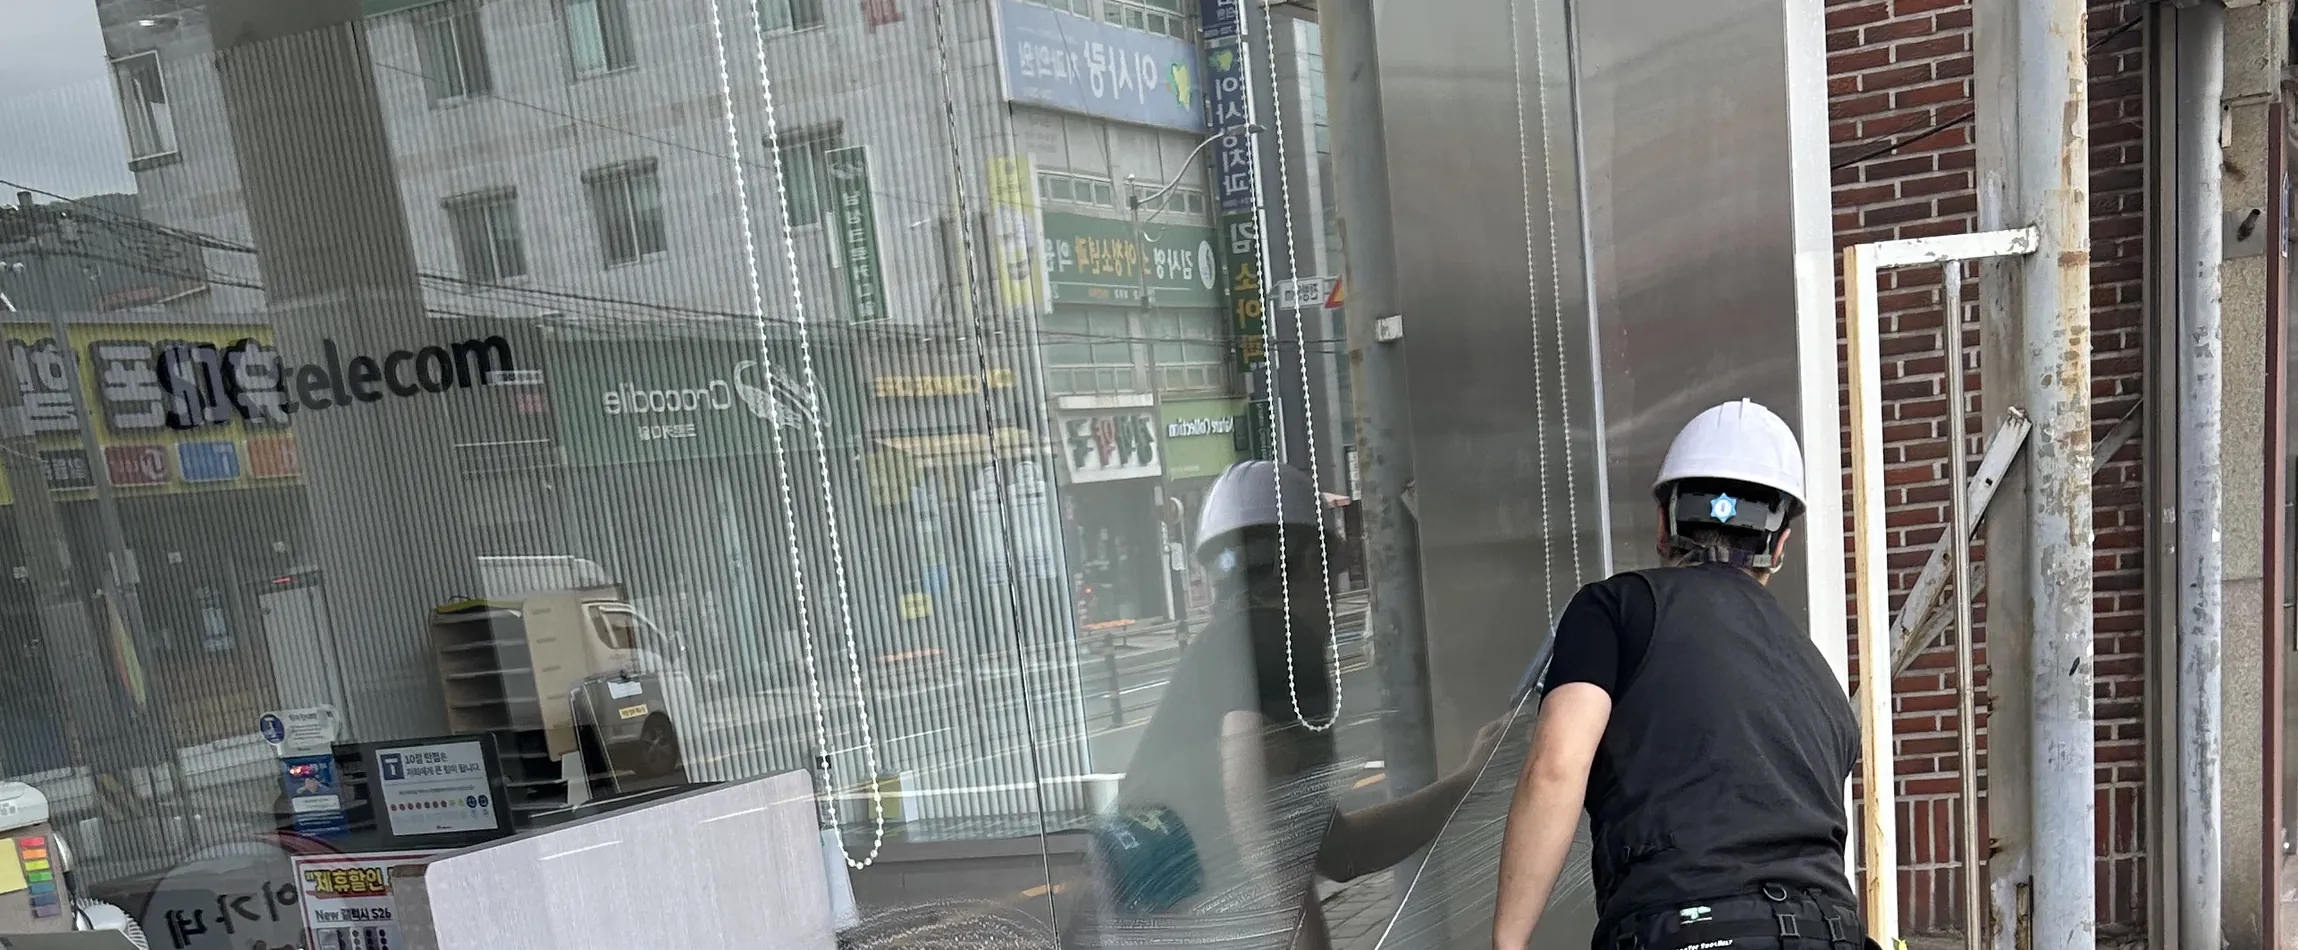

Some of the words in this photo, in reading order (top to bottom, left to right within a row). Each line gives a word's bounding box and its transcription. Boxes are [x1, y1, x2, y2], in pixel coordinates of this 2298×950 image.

[274, 334, 514, 413] telecom
[315, 909, 339, 921] New
[340, 908, 370, 920] 갤럭시
[371, 907, 392, 919] S26
